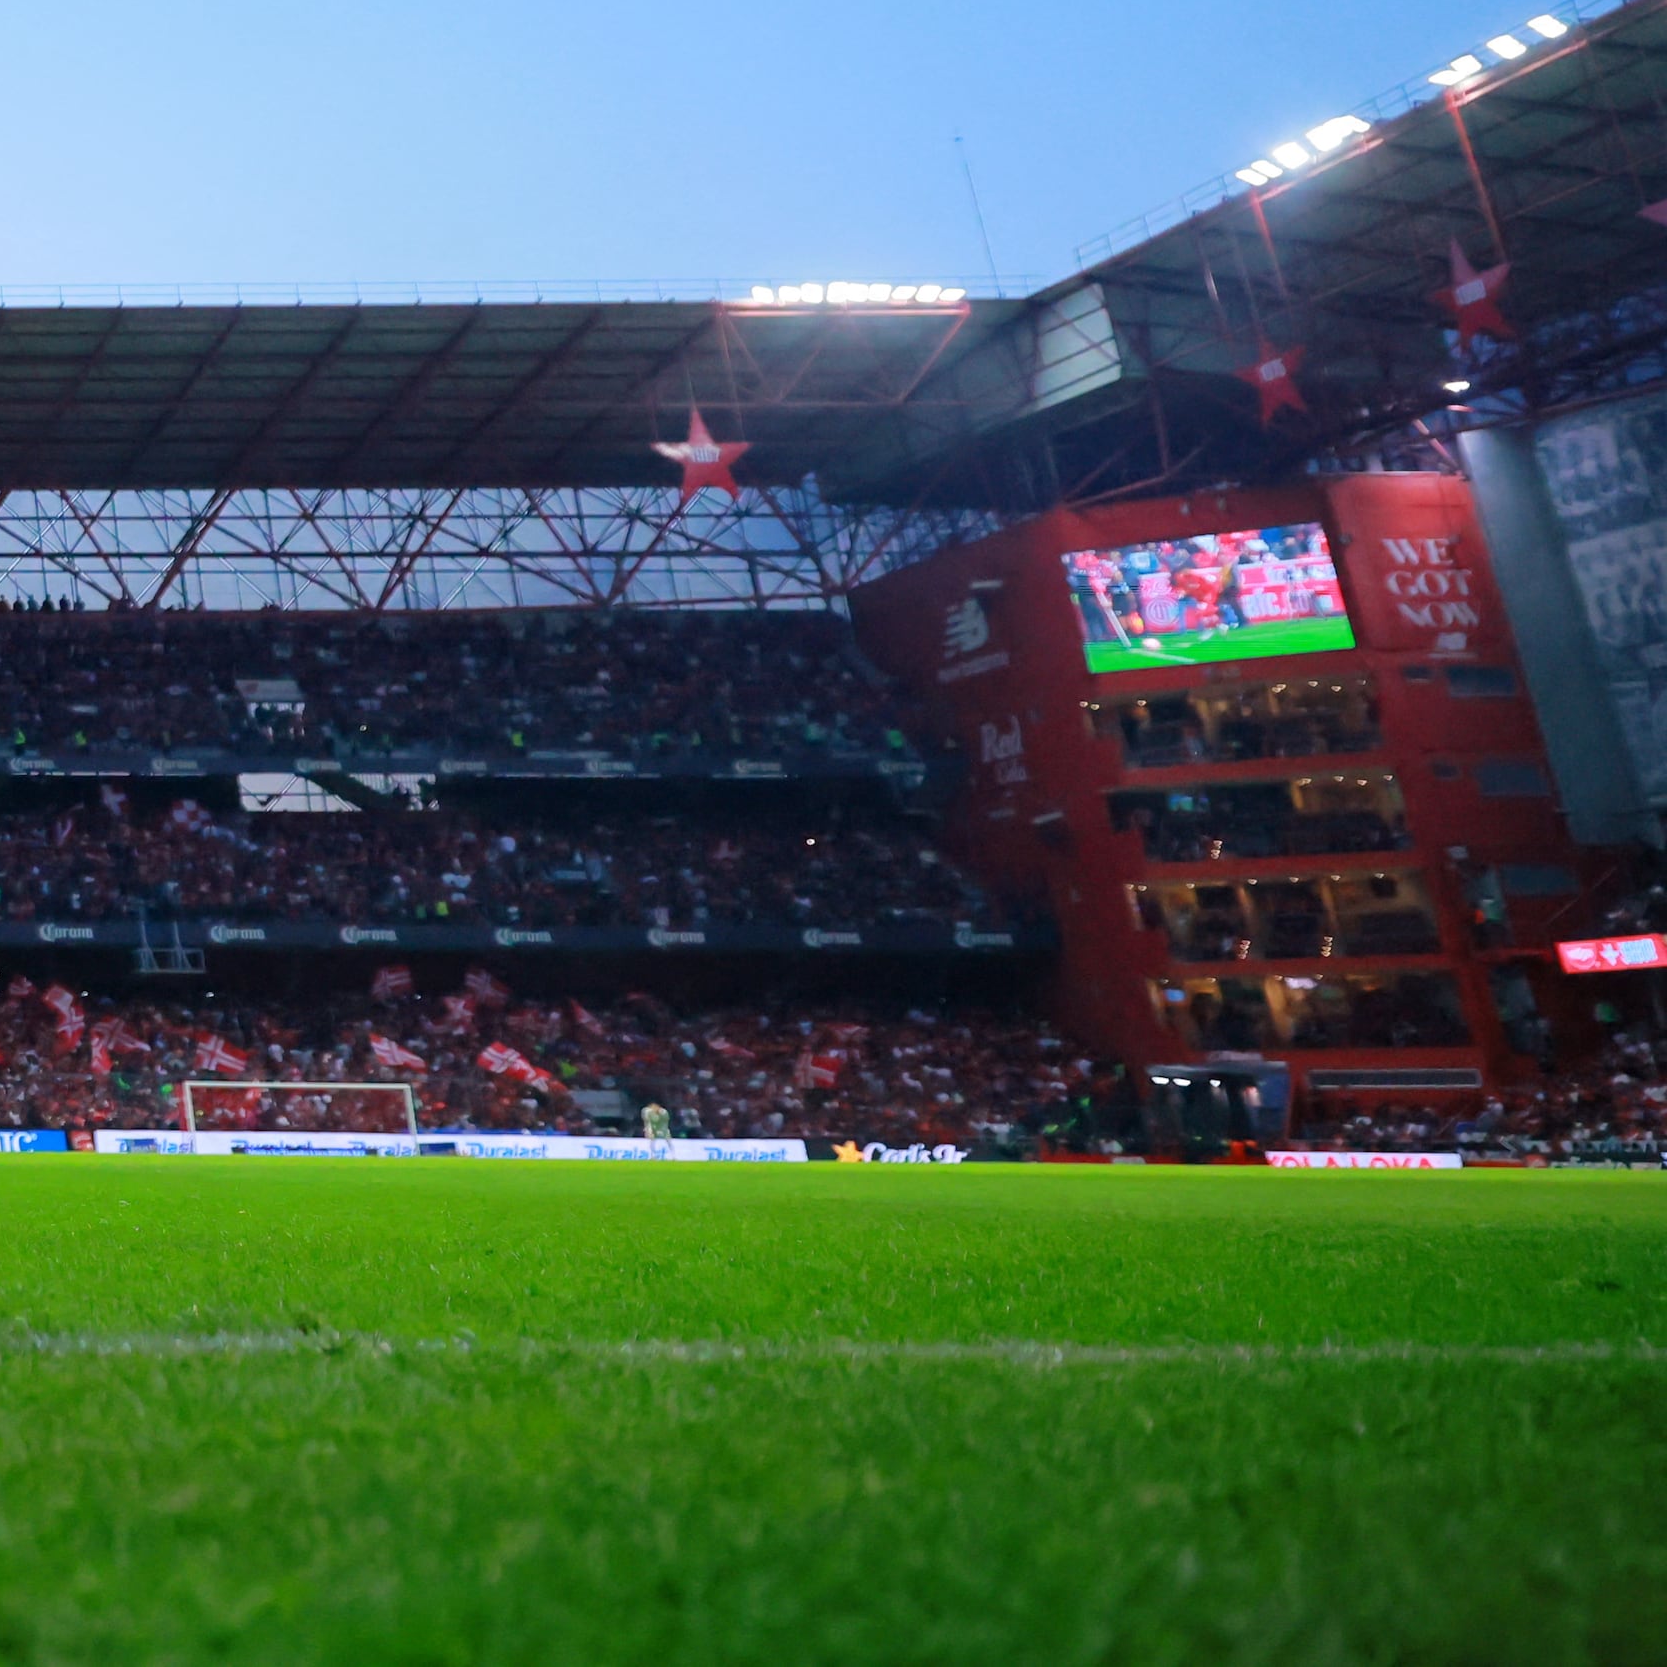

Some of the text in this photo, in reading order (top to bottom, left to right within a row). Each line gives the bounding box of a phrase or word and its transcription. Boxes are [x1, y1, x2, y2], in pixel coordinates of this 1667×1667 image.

[1382, 538, 1454, 566] WE
[1386, 569, 1473, 597] GOT
[1396, 601, 1479, 628] NOW
[39, 923, 94, 942] Corona
[210, 925, 265, 944] Corona
[339, 926, 398, 945] Corona
